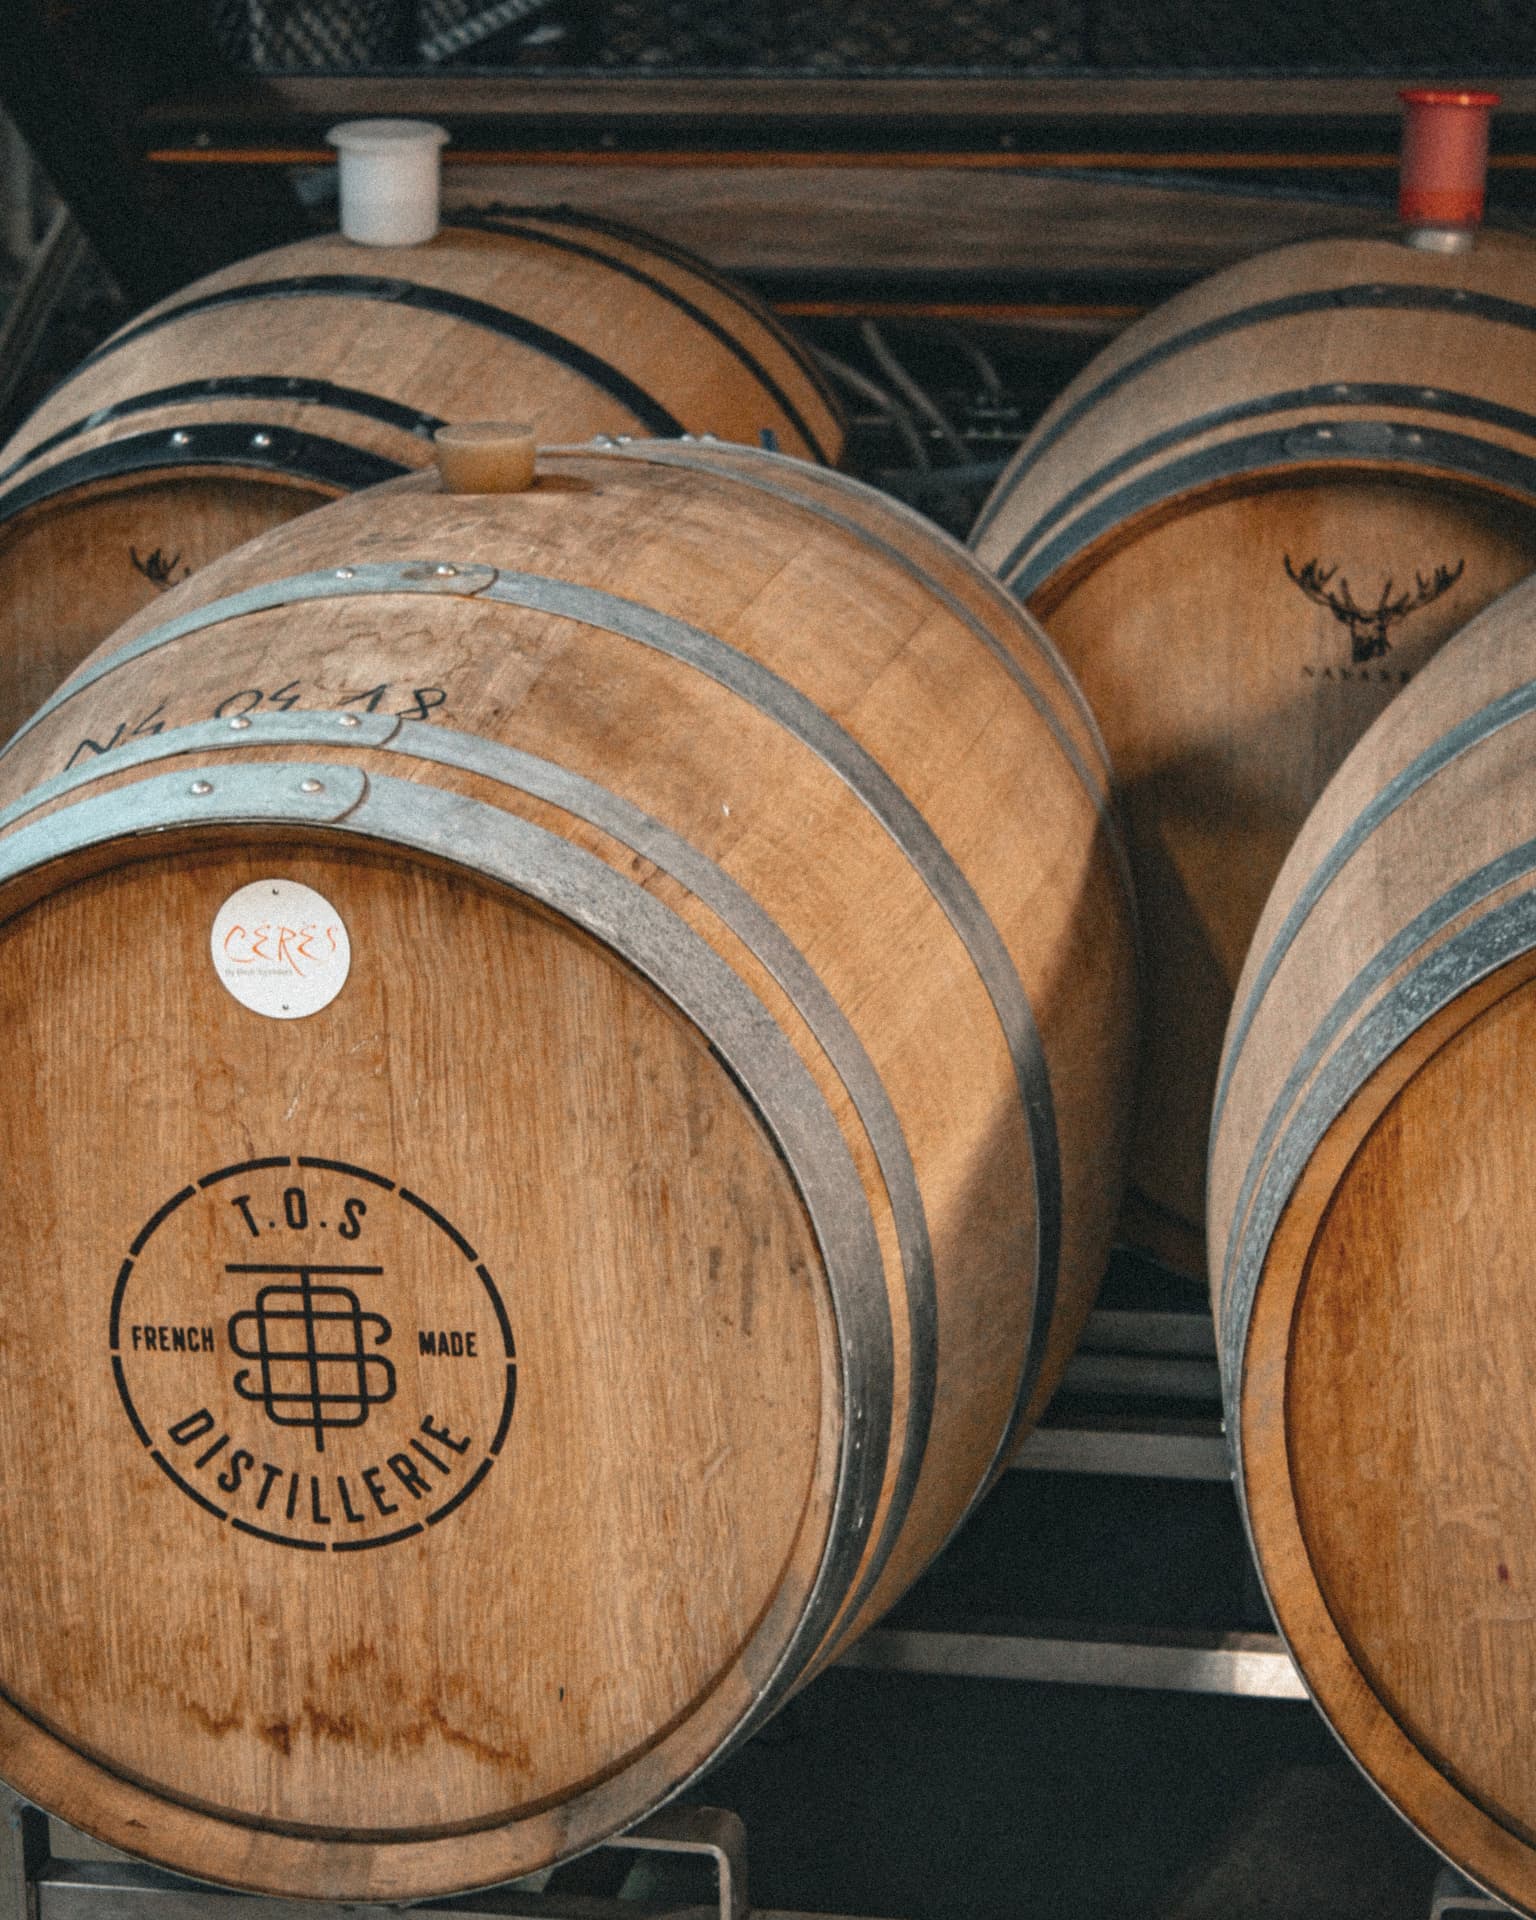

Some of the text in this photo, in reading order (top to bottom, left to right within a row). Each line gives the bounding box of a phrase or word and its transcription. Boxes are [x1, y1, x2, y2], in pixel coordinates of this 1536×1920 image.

[230, 1186, 367, 1241] T.O.S
[131, 1325, 215, 1353] FRENCH
[418, 1330, 478, 1358] MADE
[167, 1407, 472, 1525] DISTILLERIE
